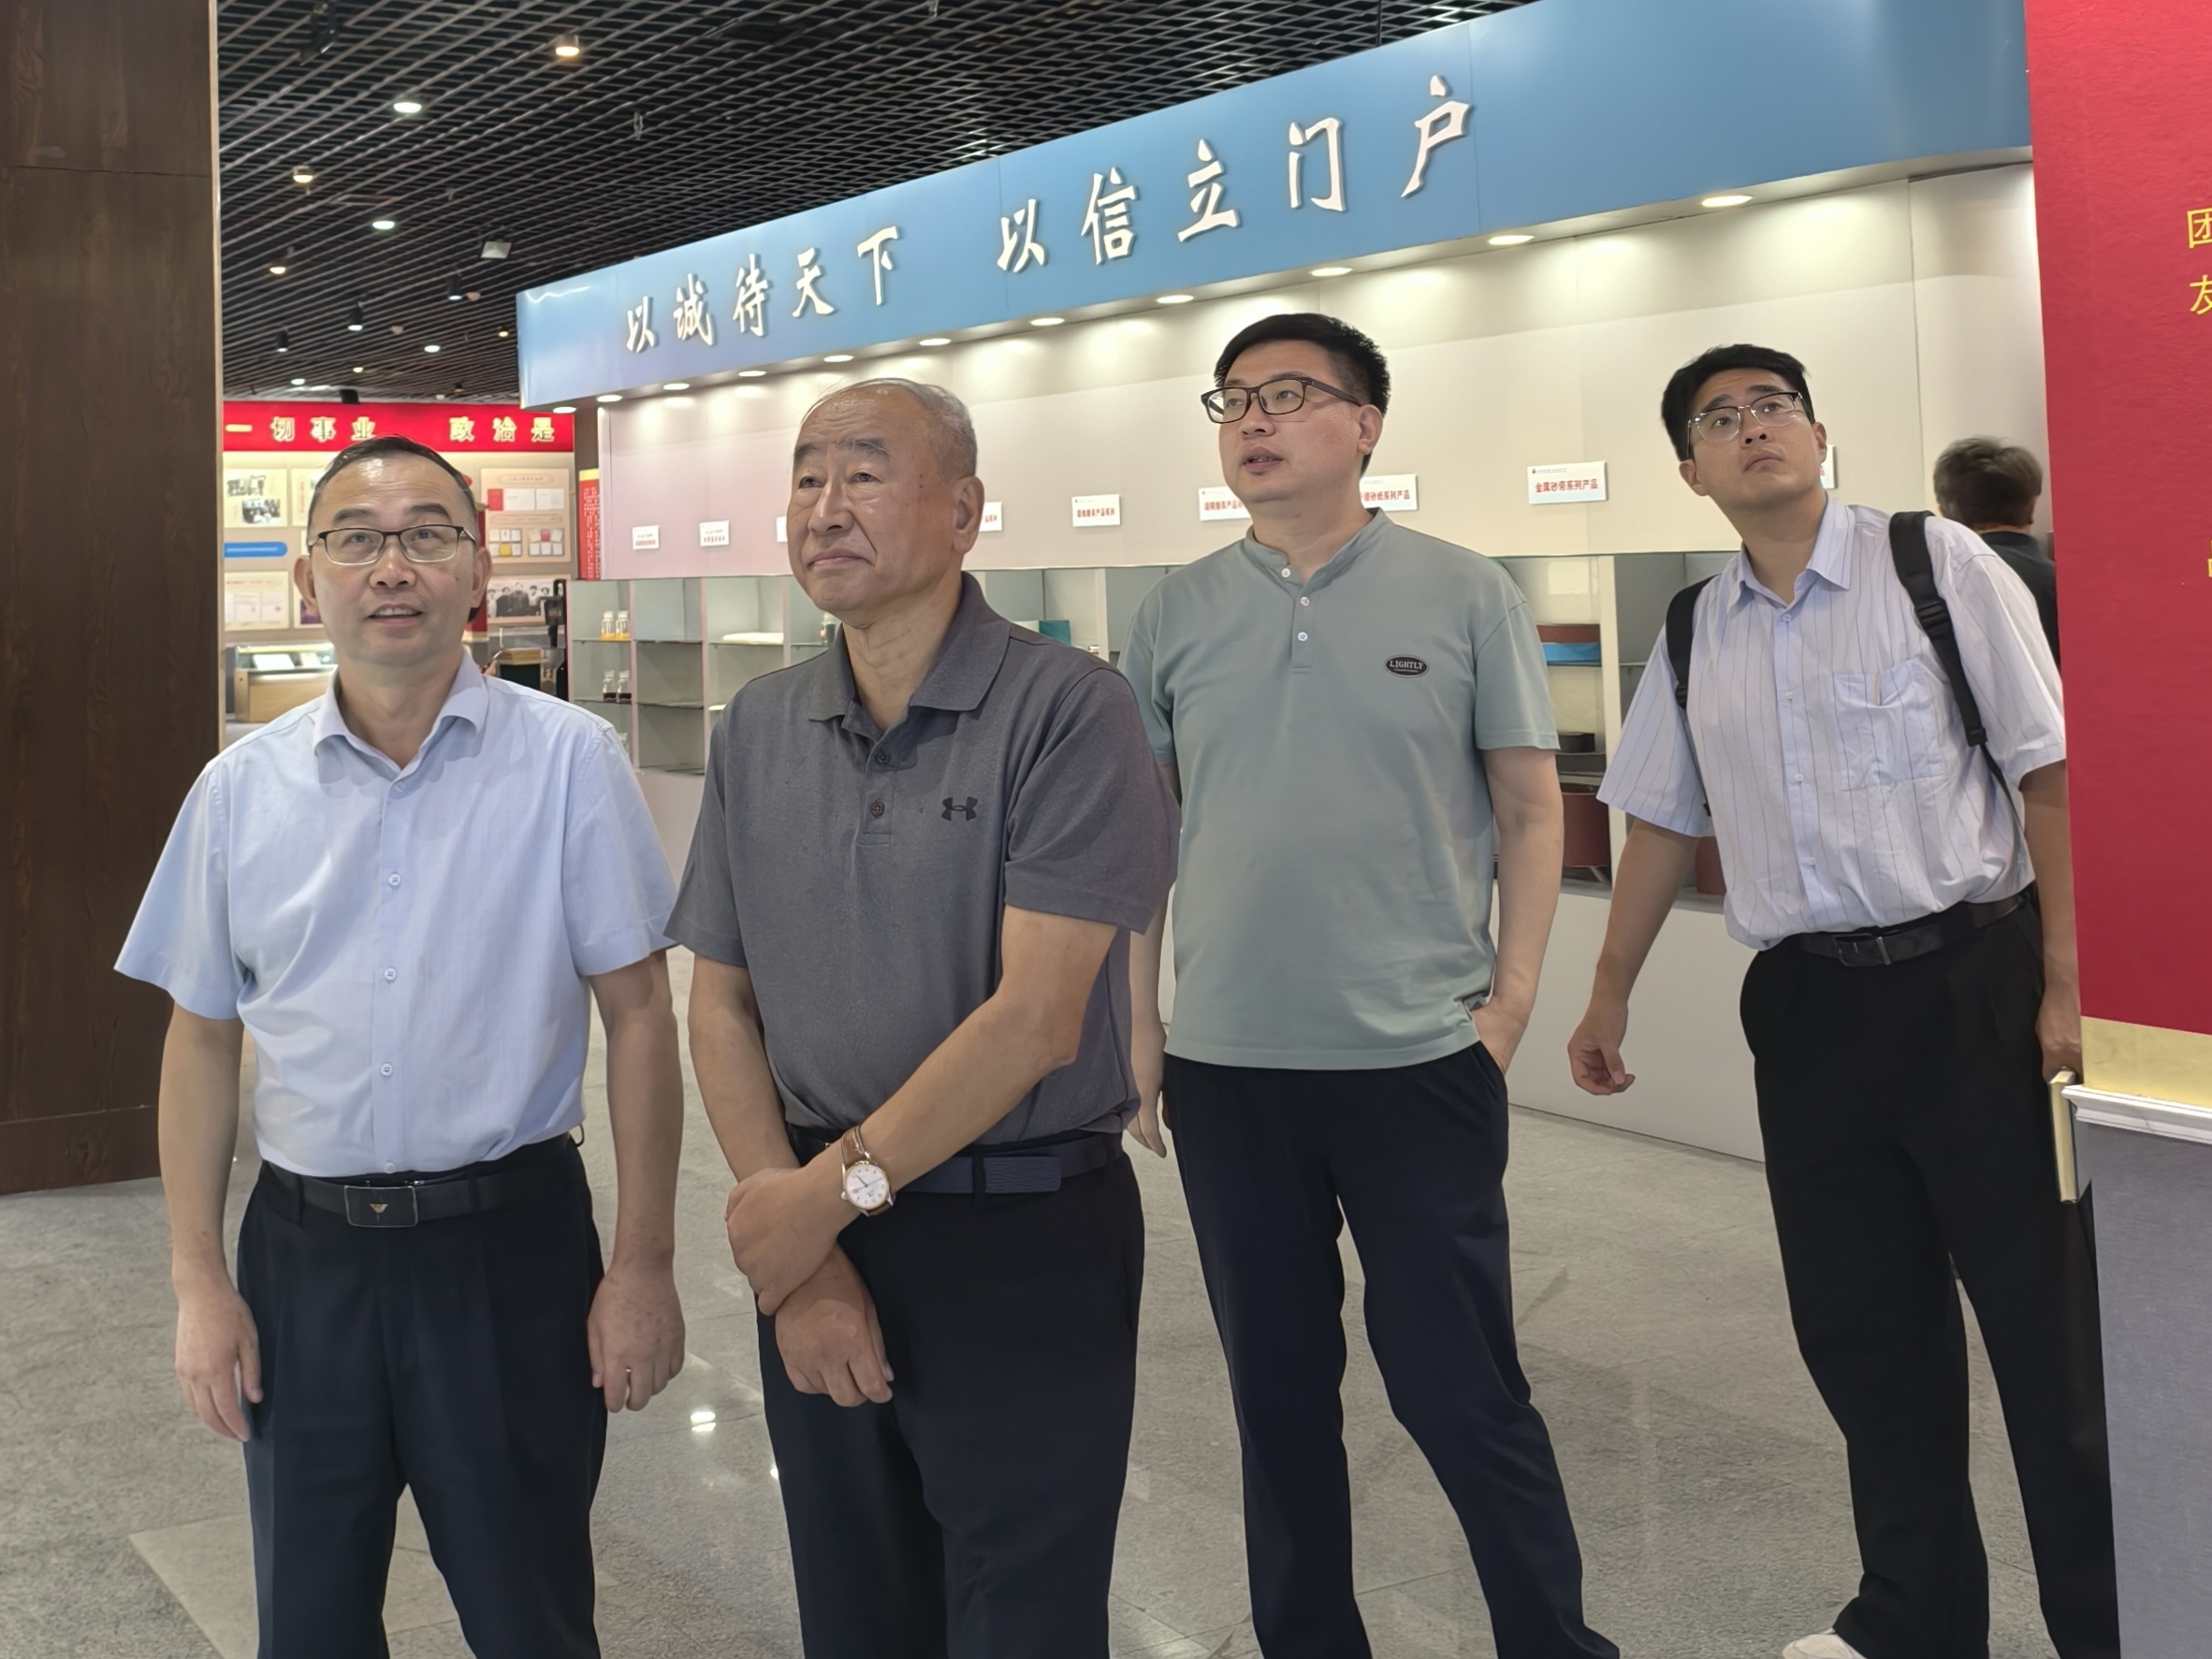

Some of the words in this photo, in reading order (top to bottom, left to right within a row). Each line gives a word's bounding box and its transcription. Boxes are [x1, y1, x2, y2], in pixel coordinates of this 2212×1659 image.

[625, 225, 900, 354] 以诚待天下
[997, 74, 1474, 273] 以信立门户
[225, 416, 376, 442] 一切事业
[449, 416, 555, 442] 政治是
[1390, 660, 1423, 670] LIGHTLY
